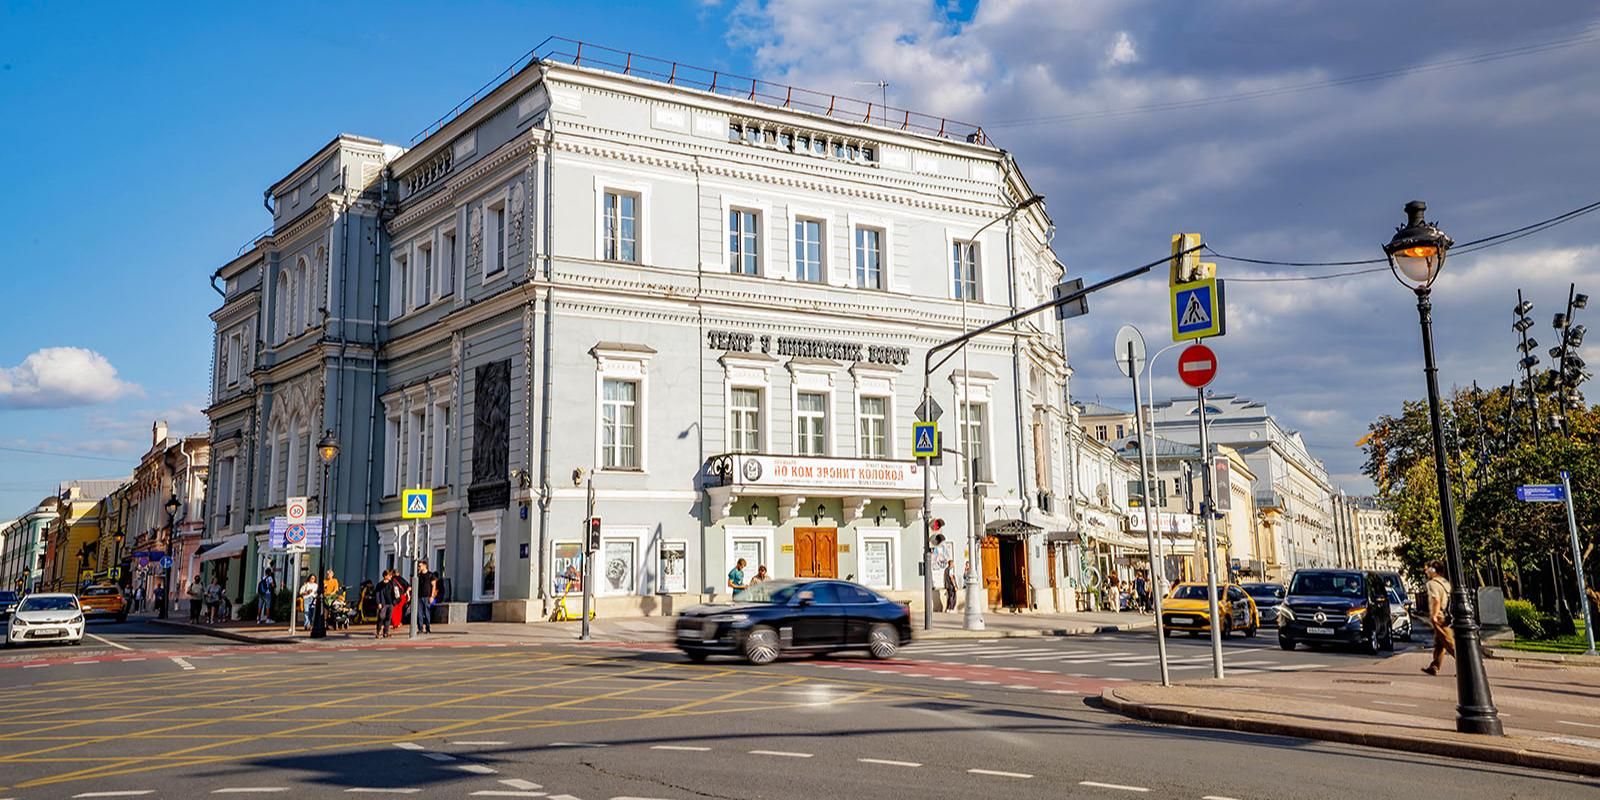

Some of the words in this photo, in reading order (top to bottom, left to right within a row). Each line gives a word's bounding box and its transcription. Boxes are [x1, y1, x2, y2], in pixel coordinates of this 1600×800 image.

[707, 330, 754, 352] ТЕАТР
[760, 334, 772, 354] У
[777, 337, 863, 361] НИКИТСКИХ
[868, 344, 910, 366] ВОРОТ
[774, 465, 788, 477] ПО
[791, 466, 813, 478] КОМ
[816, 467, 856, 480] ЗВОНИТ
[858, 468, 904, 481] КОЛОКОЛ
